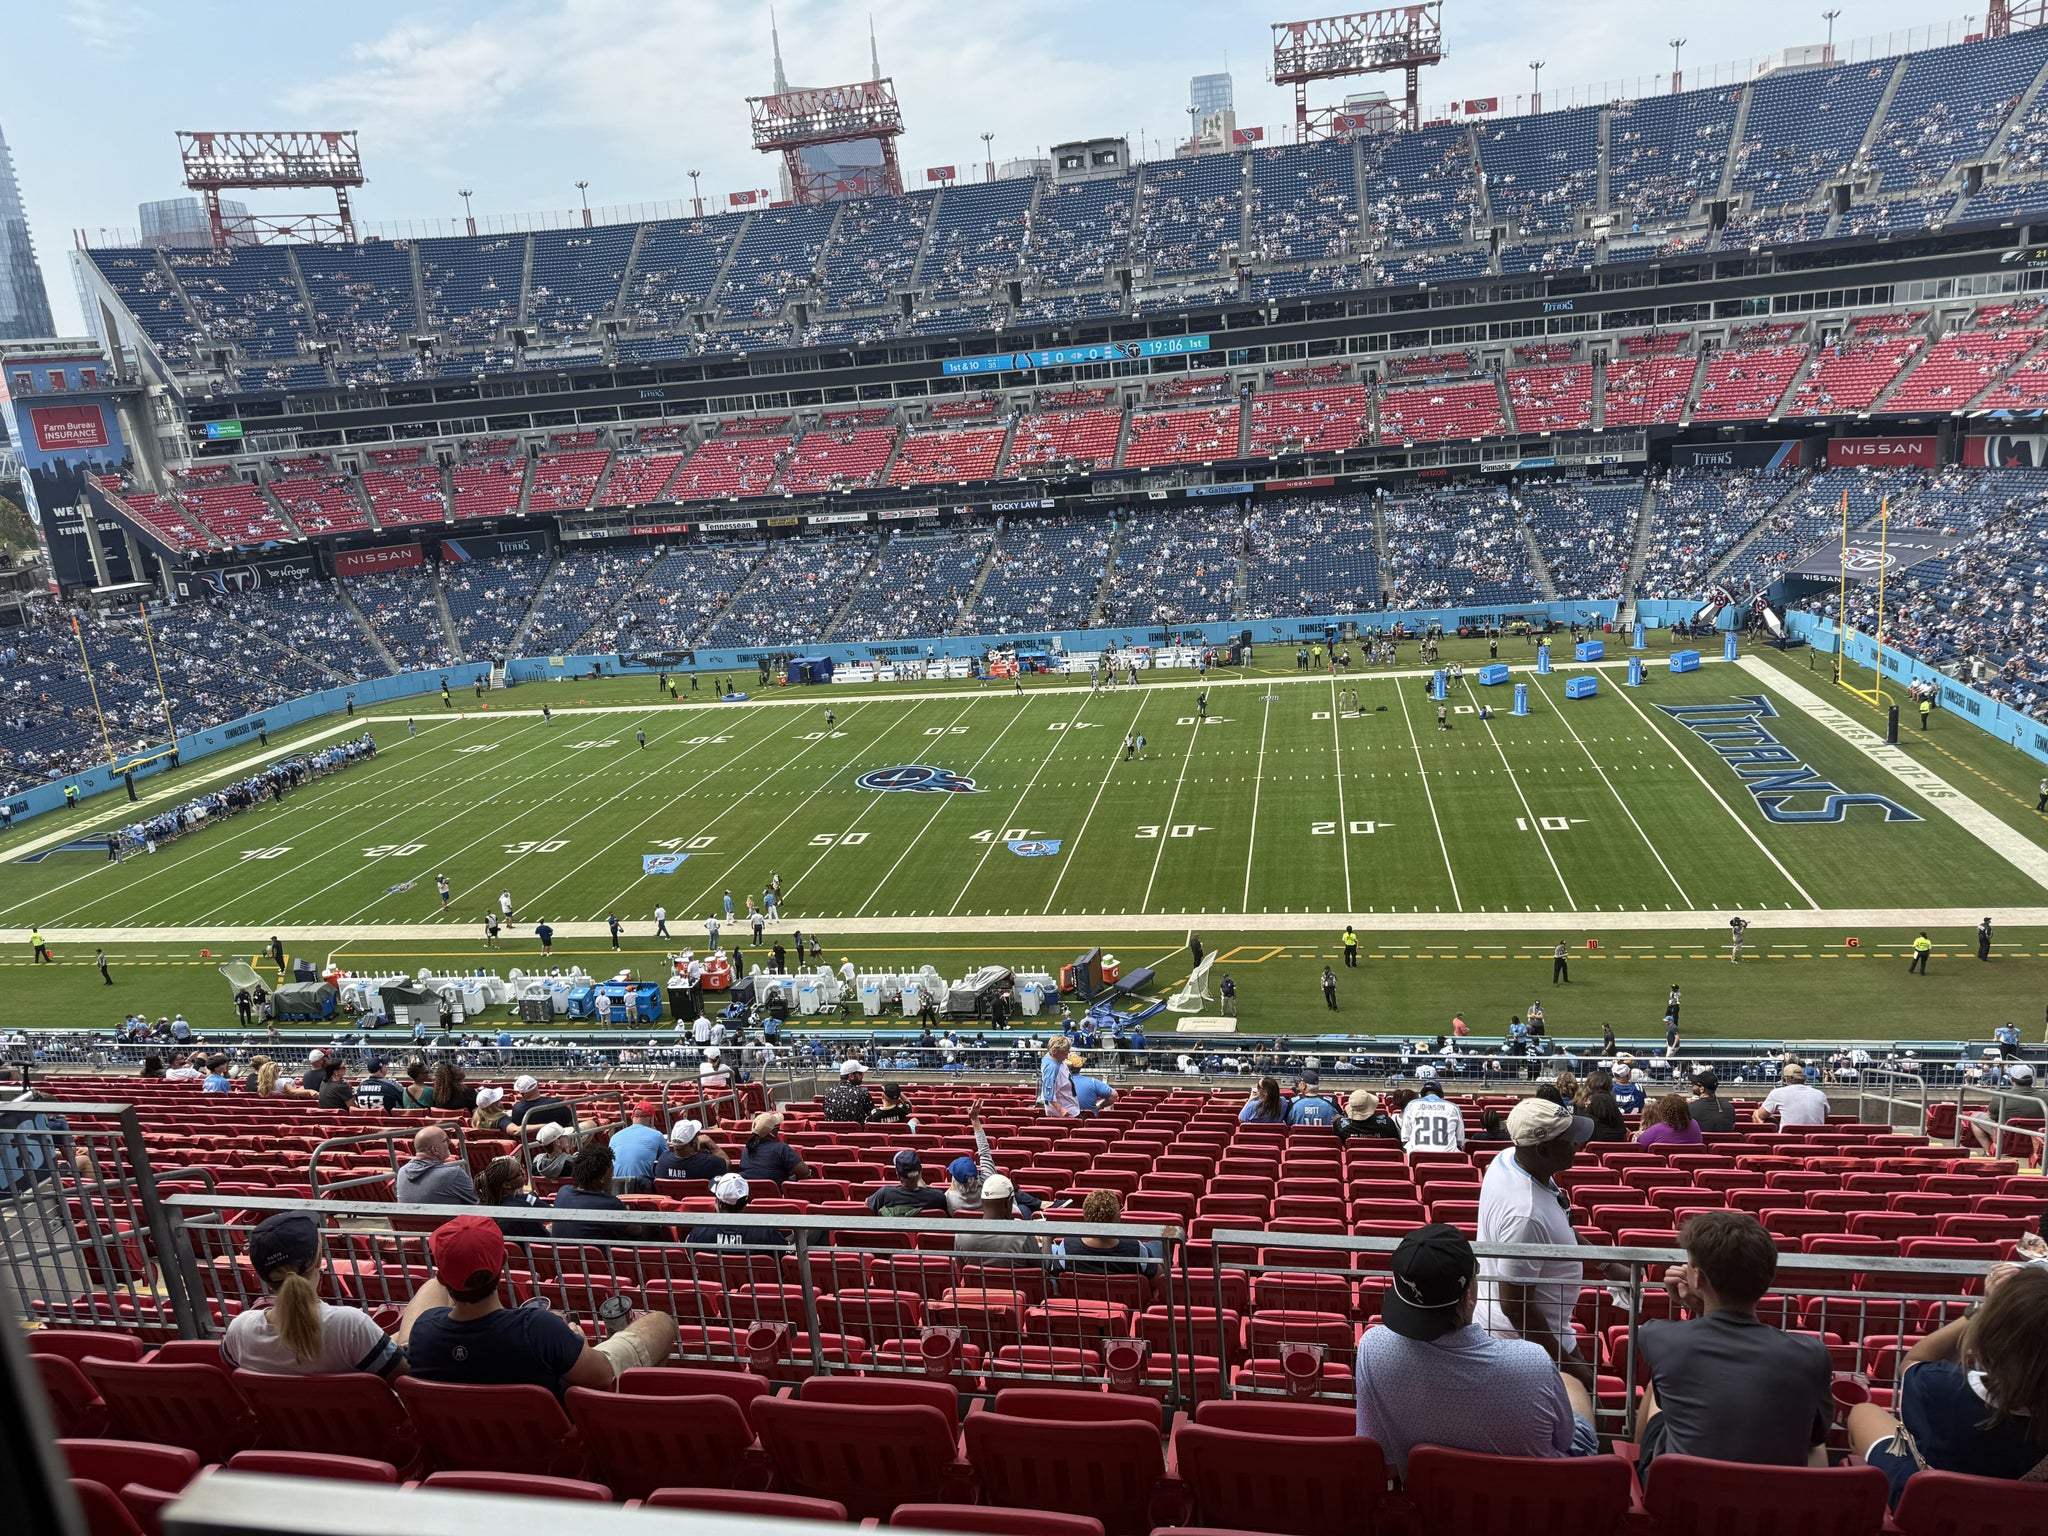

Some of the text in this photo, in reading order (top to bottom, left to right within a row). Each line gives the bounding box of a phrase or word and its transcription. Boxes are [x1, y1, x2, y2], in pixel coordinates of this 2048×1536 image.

[1149, 339, 1202, 354] 19:06 1st
[1055, 352, 1064, 363] 0
[1089, 349, 1098, 359] 0
[961, 362, 969, 370] &
[970, 361, 979, 370] 10
[44, 422, 96, 432] Farm Bureau
[45, 429, 97, 440] INSURANCE
[1841, 443, 1923, 456] NISSAN
[1693, 451, 1732, 466] TITANS
[1603, 468, 1629, 476] FISHER
[1208, 486, 1244, 495] Gallagher
[53, 506, 75, 517] WE
[953, 505, 975, 514] FedEx
[992, 502, 1019, 511] ROCKY
[1020, 501, 1038, 509] LAW
[705, 521, 750, 531] Tennessean
[497, 538, 530, 553] TITANS
[347, 549, 412, 566] NISSAN
[280, 564, 310, 580] Kroger
[1802, 574, 1842, 583] NISSAN
[868, 645, 919, 657] TENNESSEE TOUGH
[1943, 686, 1980, 717] TENNESSEE TOUGH
[1311, 710, 1364, 720] 20
[225, 724, 250, 741] TENNESSEE
[924, 726, 969, 736] 50
[1649, 695, 1926, 823] TITANS
[1311, 821, 1375, 836] 20
[1516, 816, 1570, 831] 10
[969, 829, 1028, 843] 40
[1135, 824, 1196, 839] 30
[660, 836, 718, 849] 40
[808, 832, 871, 847] 50
[245, 847, 293, 859] 10
[368, 844, 428, 858] 20
[507, 840, 571, 854] 30
[1588, 940, 1598, 949] 10
[1847, 938, 1858, 948] G
[1112, 967, 1119, 977] G
[710, 975, 720, 987] G
[1304, 1106, 1319, 1115] BRITT
[1417, 1103, 1447, 1112] JOHNSON
[1414, 1116, 1449, 1146] 28
[668, 1168, 687, 1178] WARD
[716, 1233, 743, 1245] WARD
